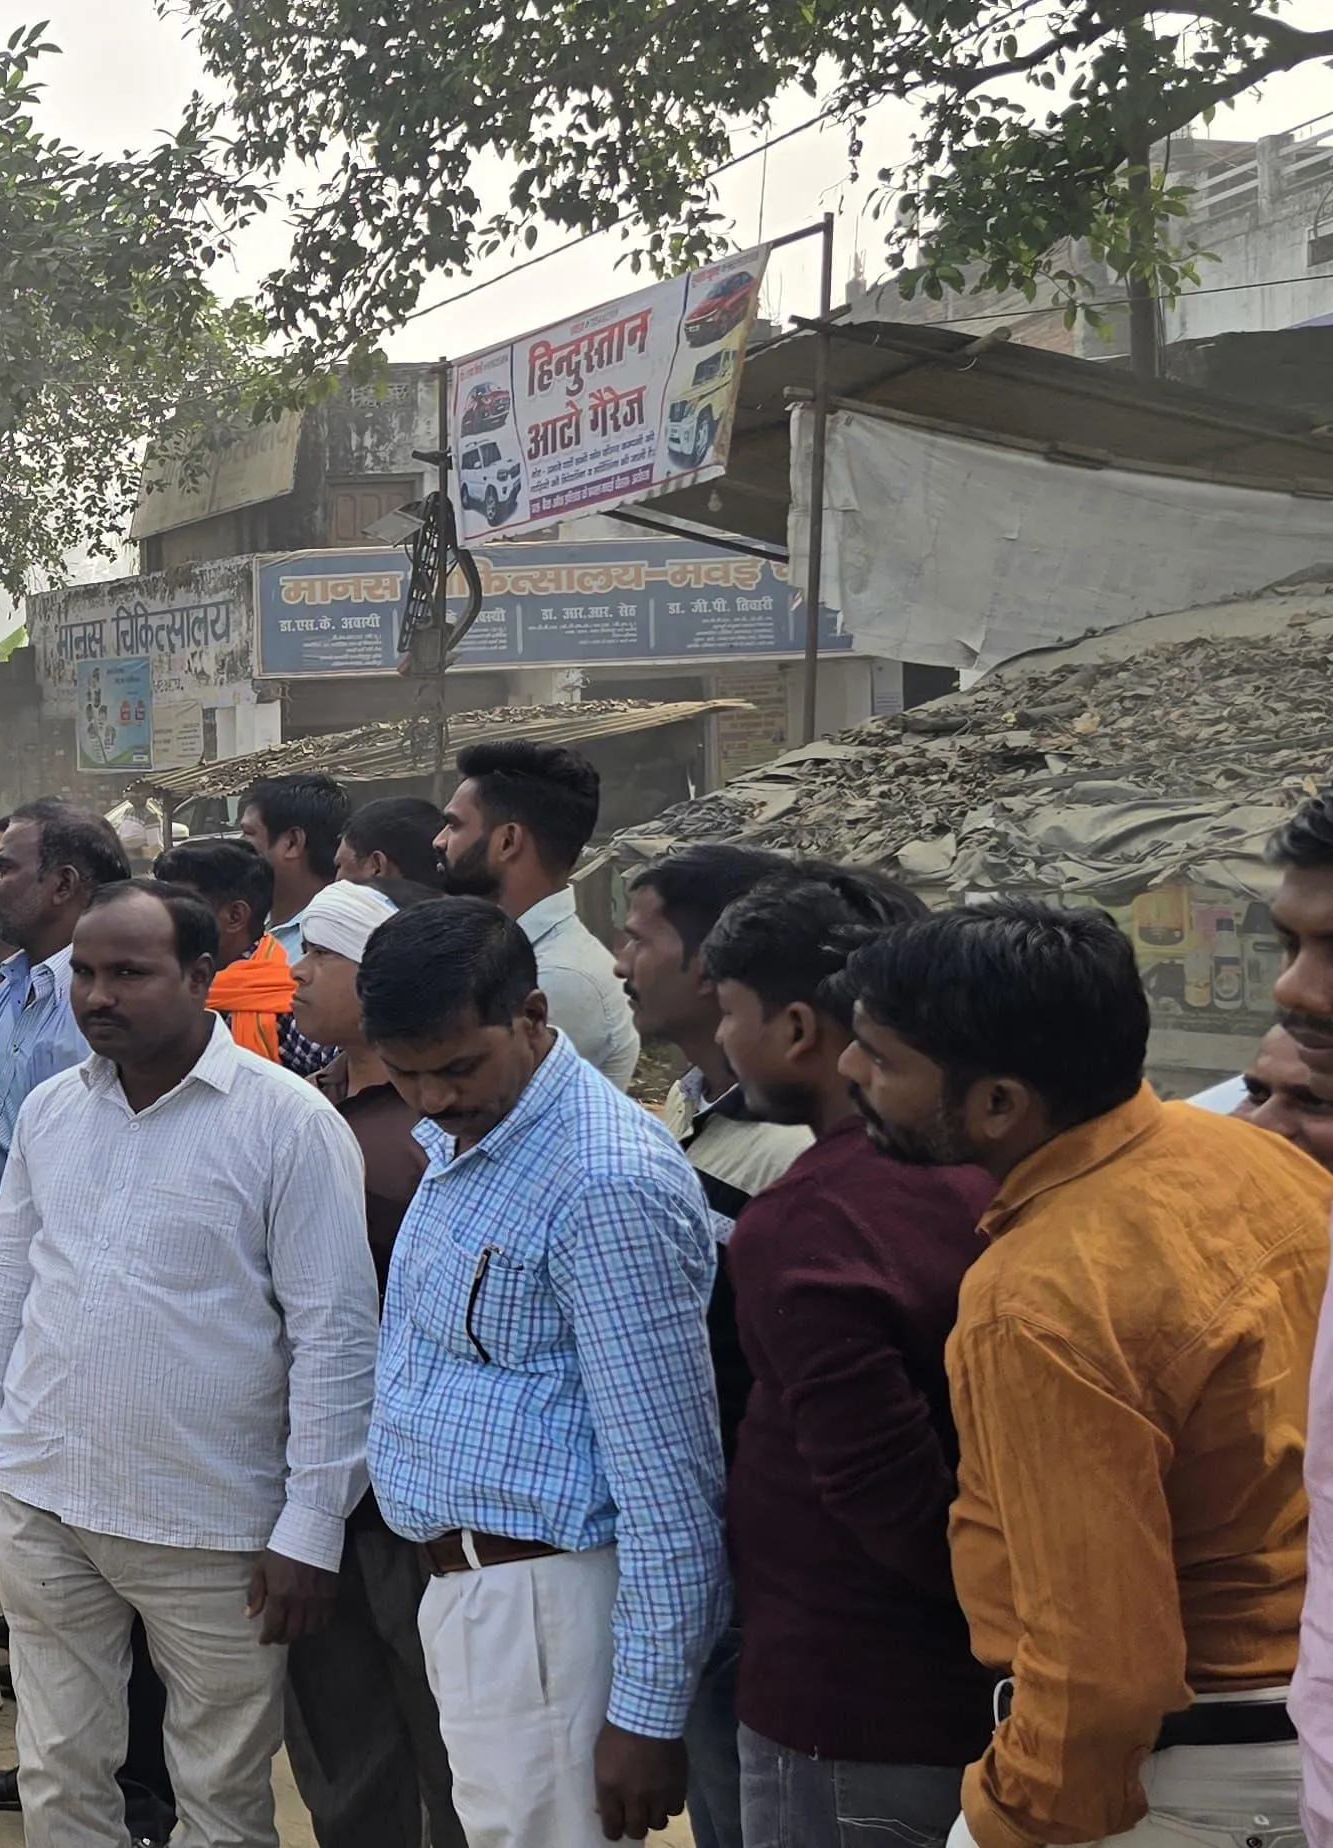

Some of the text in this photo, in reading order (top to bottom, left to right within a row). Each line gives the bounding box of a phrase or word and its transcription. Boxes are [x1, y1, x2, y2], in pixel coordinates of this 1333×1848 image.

[526, 307, 653, 398] हिन्दुस्तान
[588, 385, 647, 438] गैरेज
[279, 571, 405, 605] मानस
[57, 600, 233, 660] मानस चिकित्सालय
